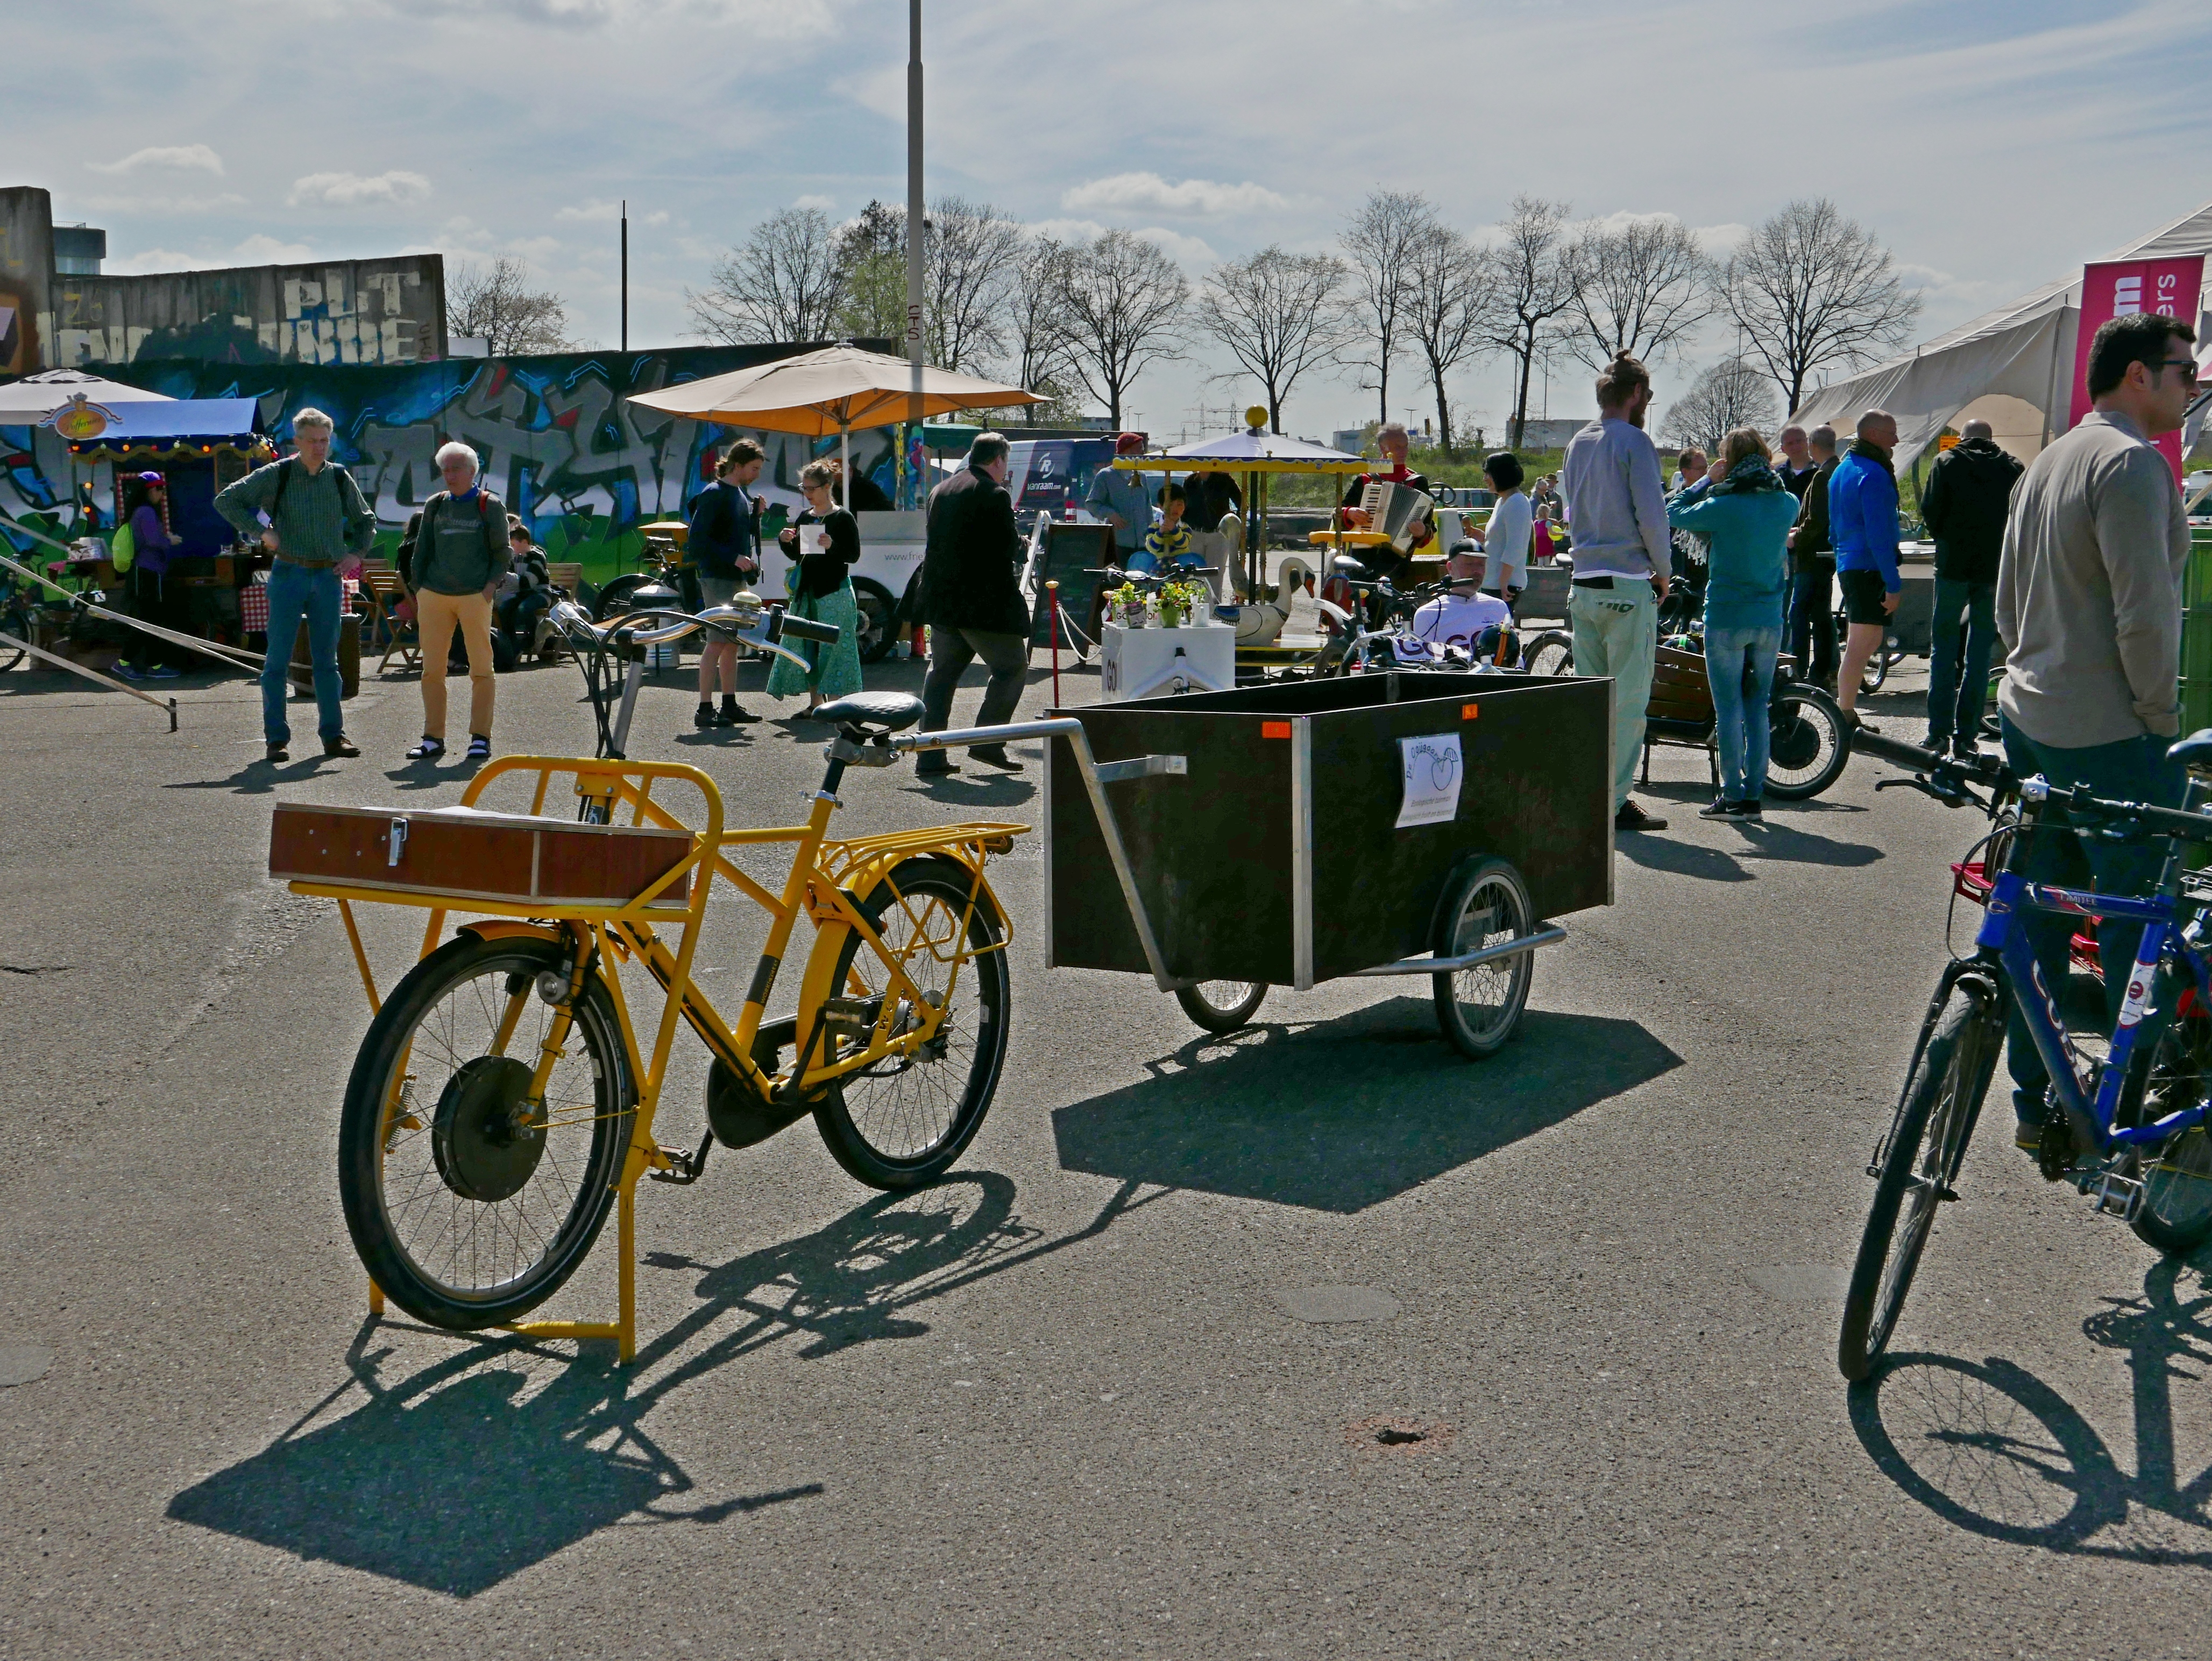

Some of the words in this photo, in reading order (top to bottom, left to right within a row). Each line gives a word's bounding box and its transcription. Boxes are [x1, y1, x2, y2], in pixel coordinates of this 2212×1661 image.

[908, 304, 920, 340] CTS
[1039, 459, 1052, 472] R
[1027, 481, 1061, 491] vanraam.com
